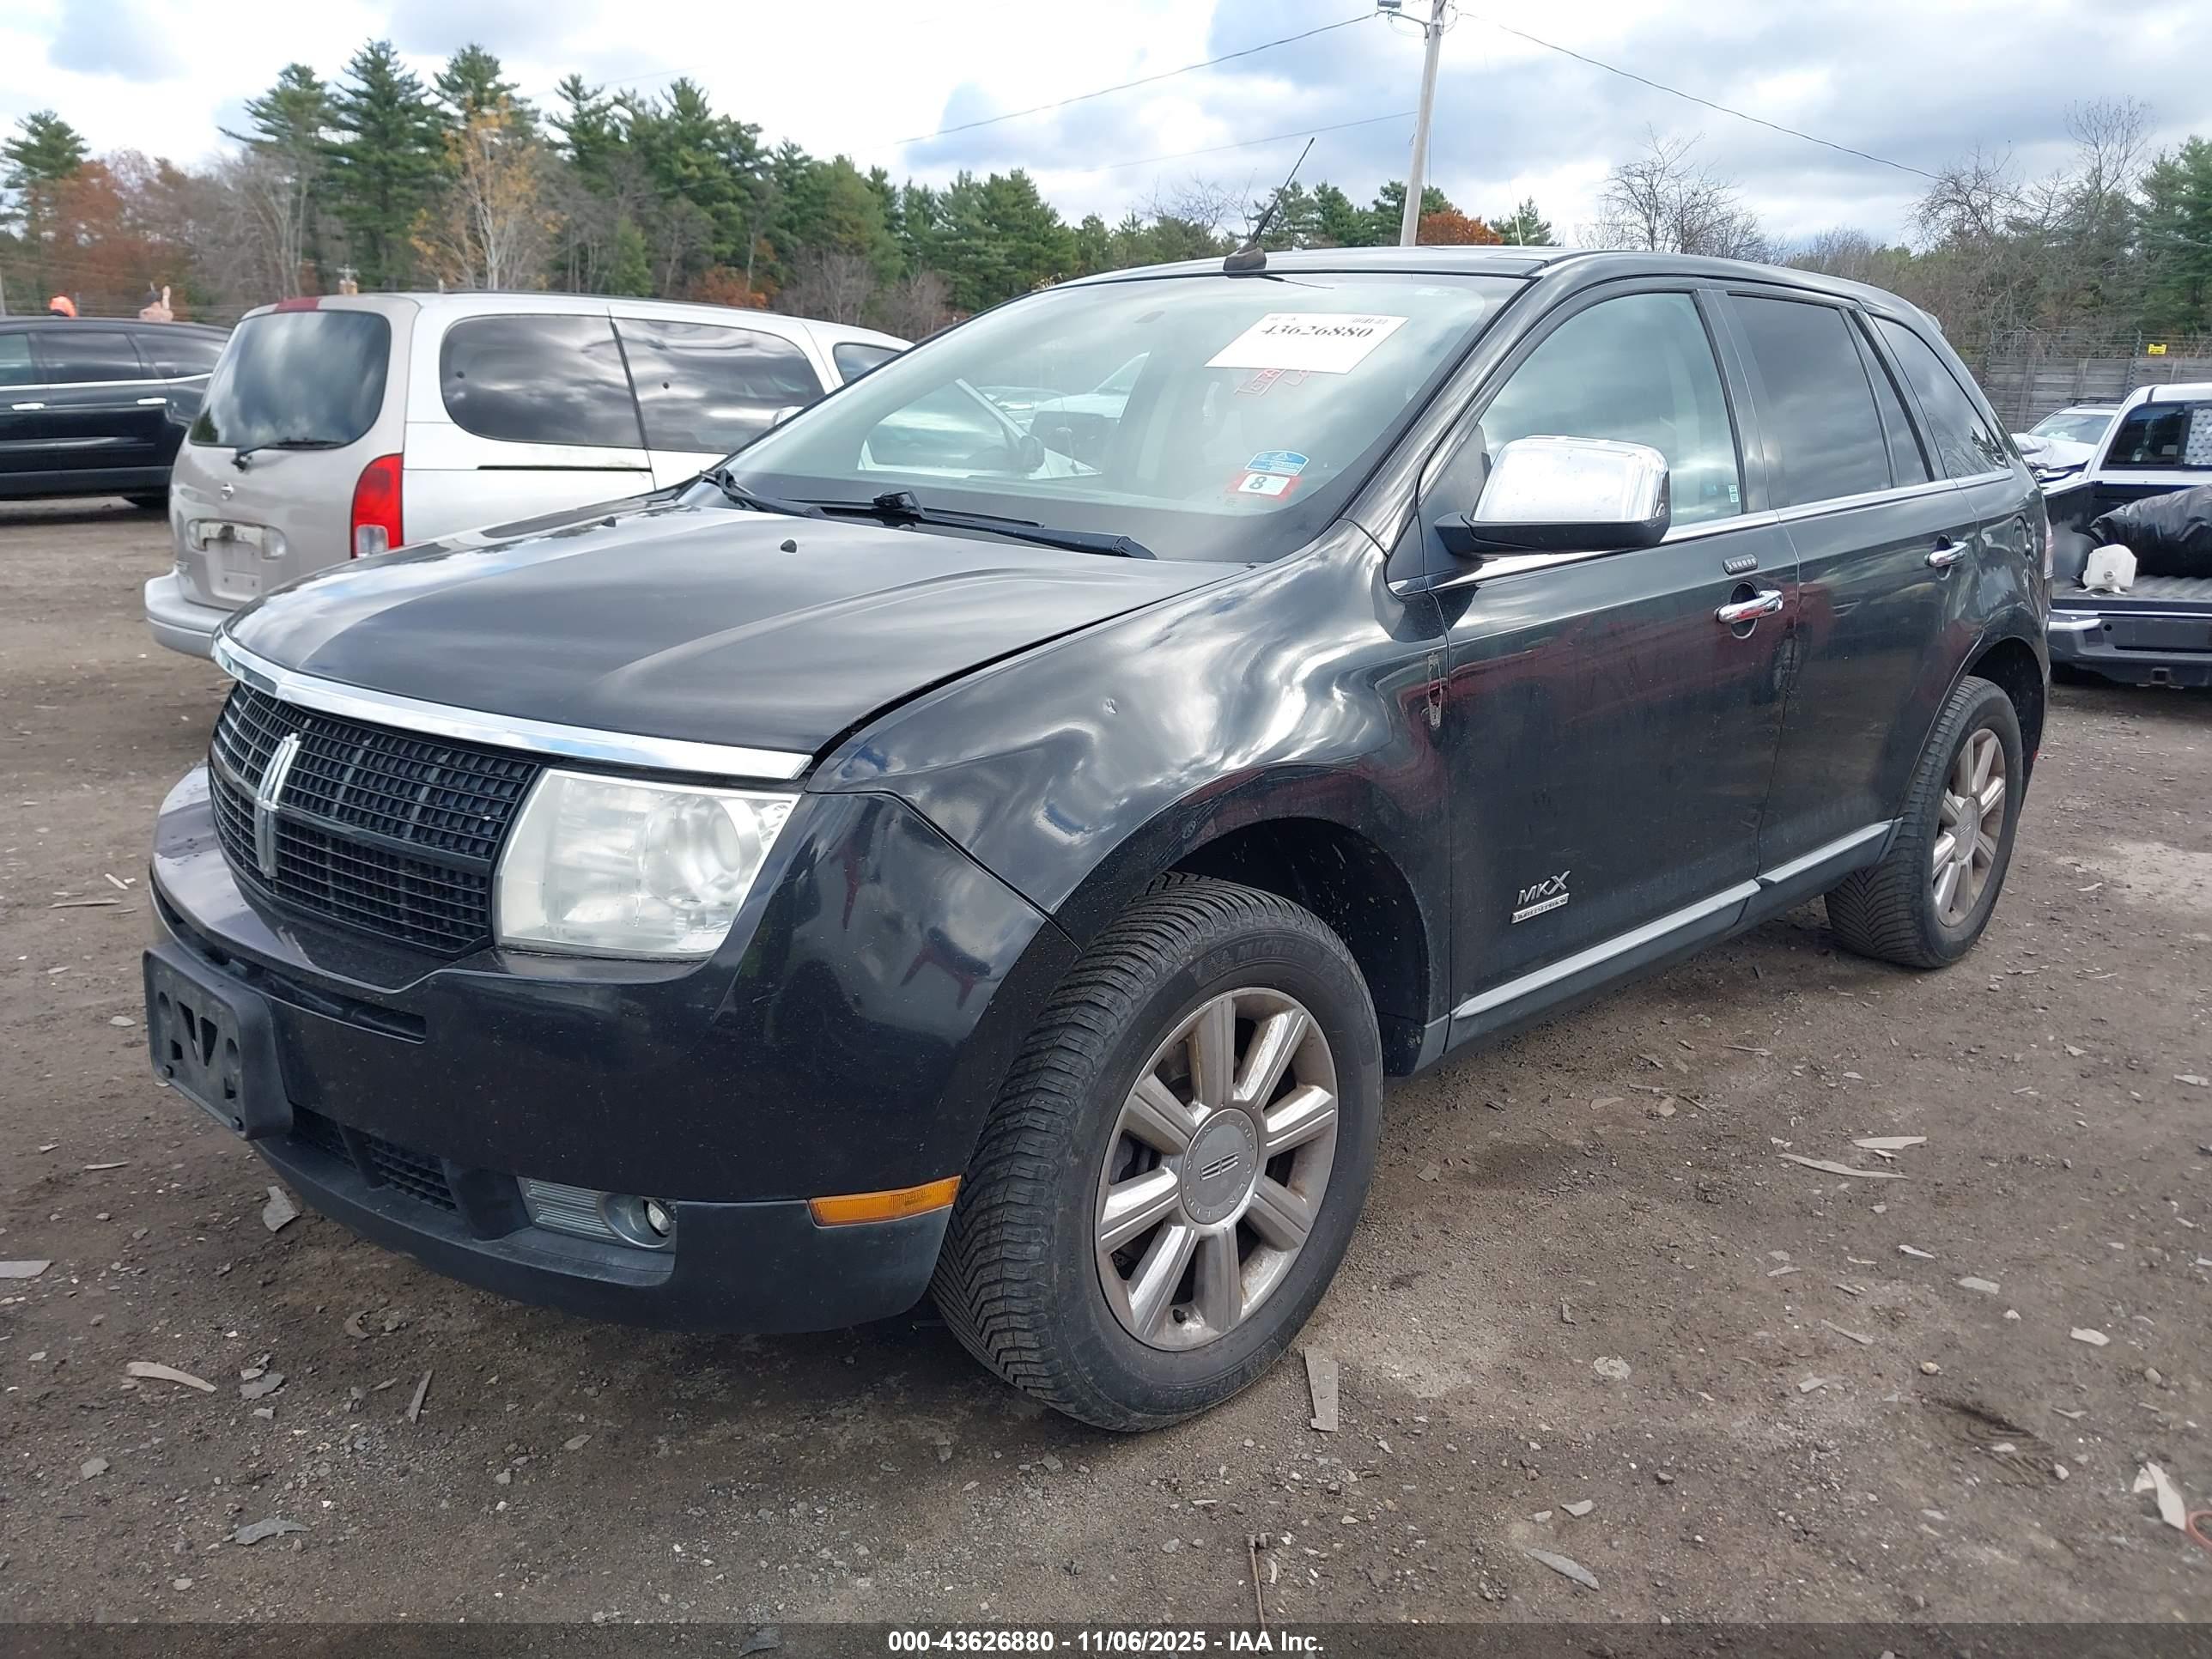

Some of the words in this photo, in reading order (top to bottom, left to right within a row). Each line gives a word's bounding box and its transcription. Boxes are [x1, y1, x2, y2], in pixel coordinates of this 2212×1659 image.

[1261, 325, 1375, 337] 43626880
[1249, 476, 1267, 489] 8
[1517, 870, 1571, 906] MKX
